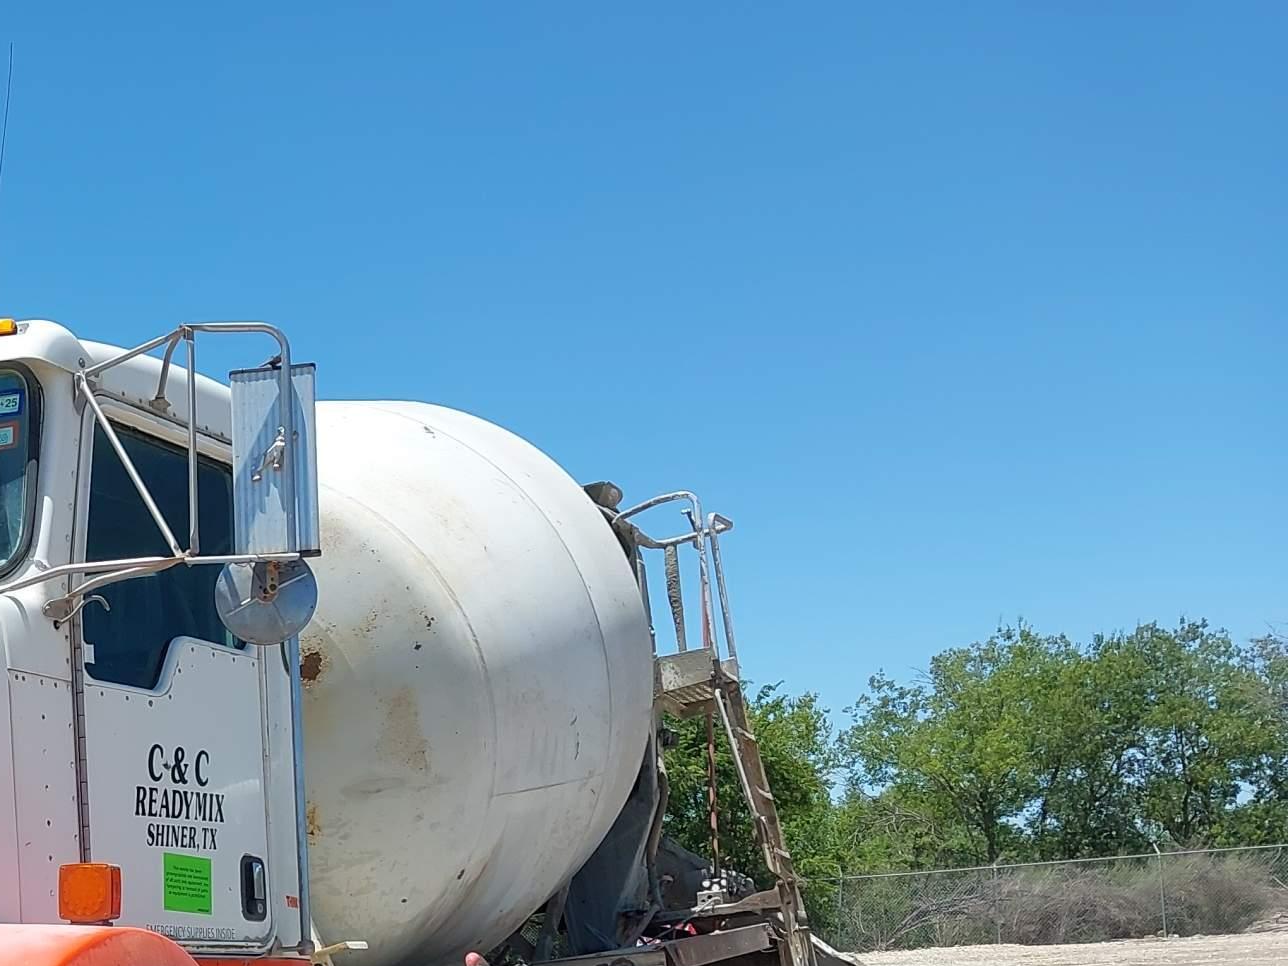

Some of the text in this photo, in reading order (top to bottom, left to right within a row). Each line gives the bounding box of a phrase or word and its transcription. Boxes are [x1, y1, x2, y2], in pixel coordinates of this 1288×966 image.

[5, 398, 17, 408] 25
[148, 744, 210, 787] C & C
[135, 786, 224, 823] READYMIX
[146, 924, 236, 940] EMERGENCY SUPPLIES INSIDE
